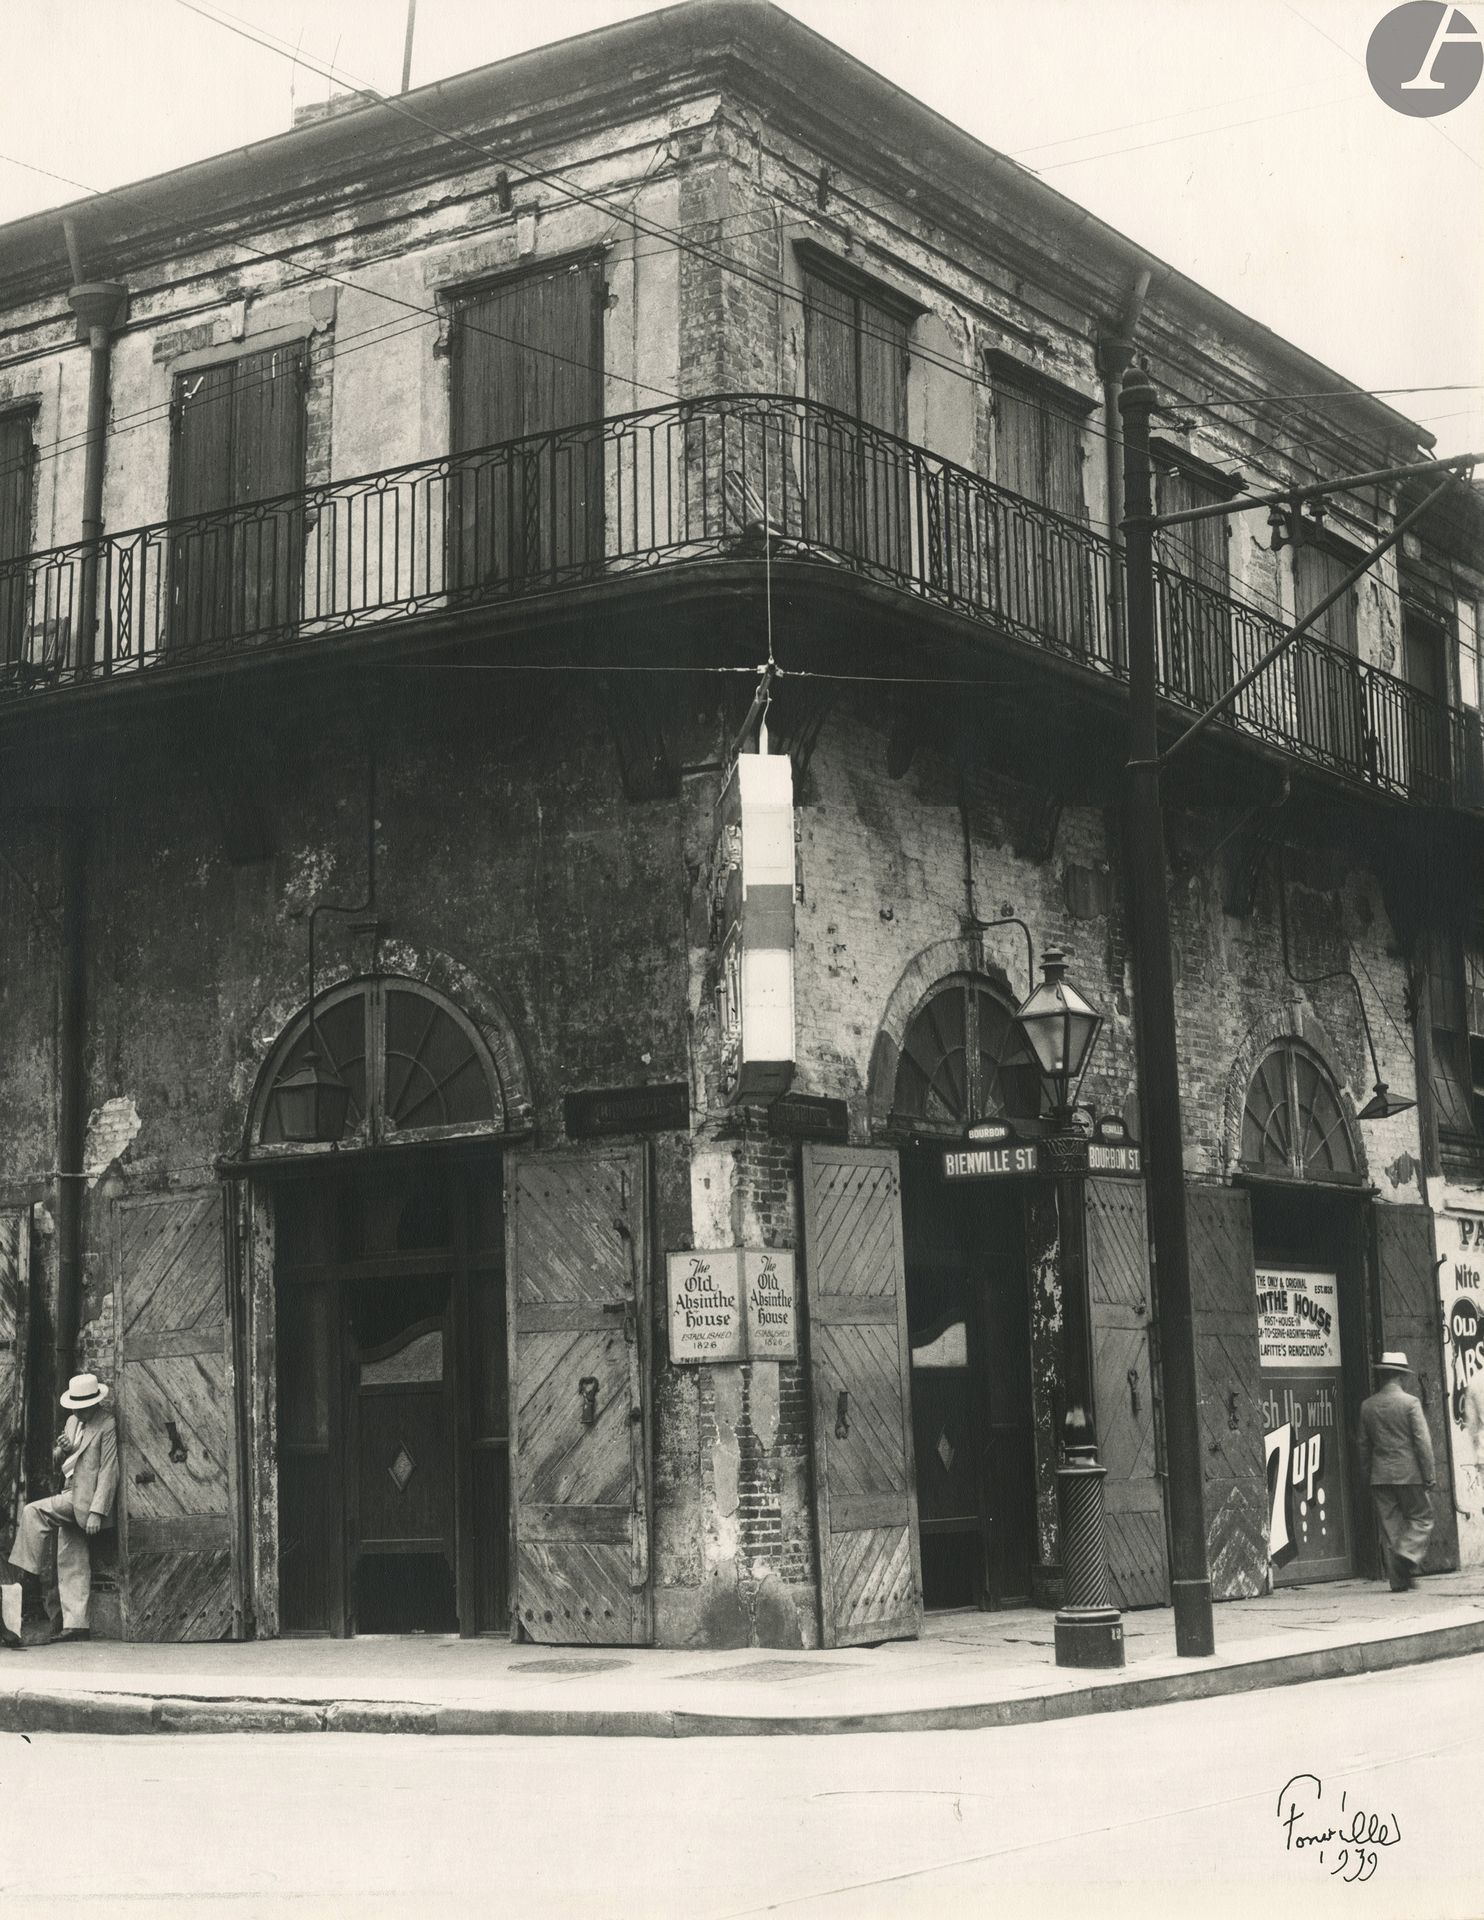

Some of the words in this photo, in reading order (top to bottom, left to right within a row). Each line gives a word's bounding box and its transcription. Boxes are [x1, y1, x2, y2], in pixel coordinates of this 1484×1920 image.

[968, 1127, 1006, 1139] BOURBON
[946, 1149, 1010, 1175] BIENVILLE
[1015, 1147, 1036, 1170] ST.
[1089, 1146, 1126, 1169] BOURBON
[689, 1258, 711, 1277] The
[760, 1255, 776, 1273] The
[684, 1274, 719, 1293] Old
[757, 1272, 780, 1291] Old
[1256, 1275, 1266, 1287] THE
[1267, 1276, 1279, 1287] ONLY
[1285, 1277, 1307, 1289] ORIGINAL
[1455, 1263, 1480, 1290] Nite
[674, 1290, 736, 1311] Absinthe
[750, 1289, 793, 1308] Absinthe
[686, 1310, 731, 1329] House
[757, 1308, 788, 1327] House
[1294, 1292, 1332, 1336] HOUSE
[1453, 1315, 1477, 1336] OLD
[681, 1331, 732, 1342] ESTABLISHED
[693, 1341, 717, 1350] 1826
